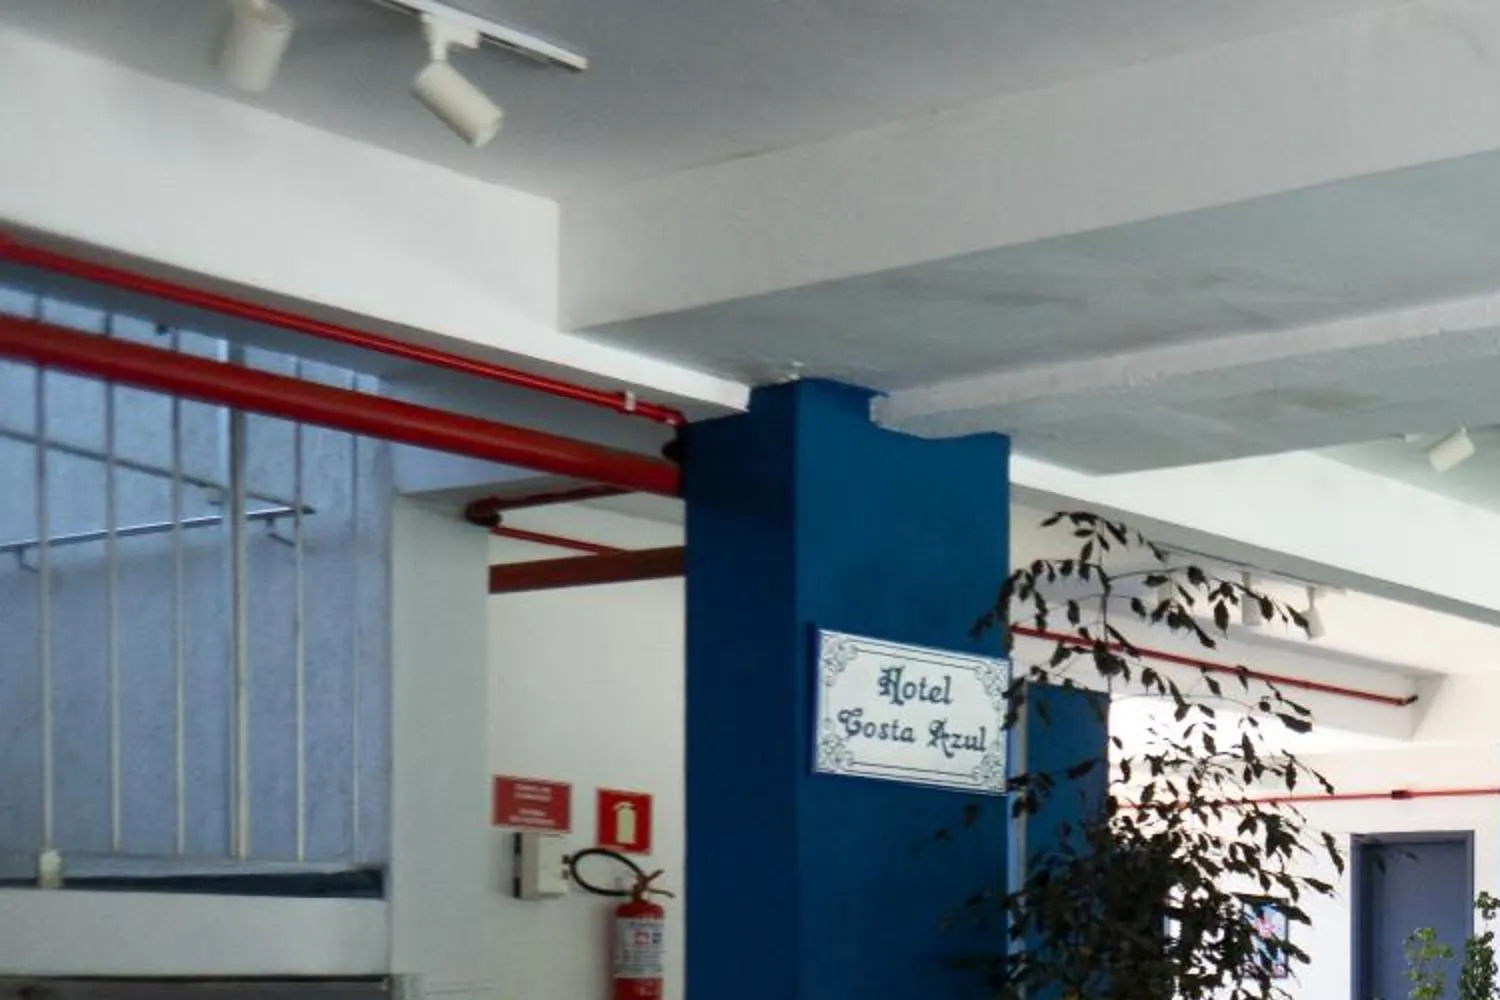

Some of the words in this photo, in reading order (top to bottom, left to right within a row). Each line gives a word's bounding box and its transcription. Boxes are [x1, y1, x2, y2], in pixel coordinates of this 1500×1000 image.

[878, 665, 954, 706] Hotel
[837, 707, 916, 744] Costa
[926, 718, 986, 759] Azul
